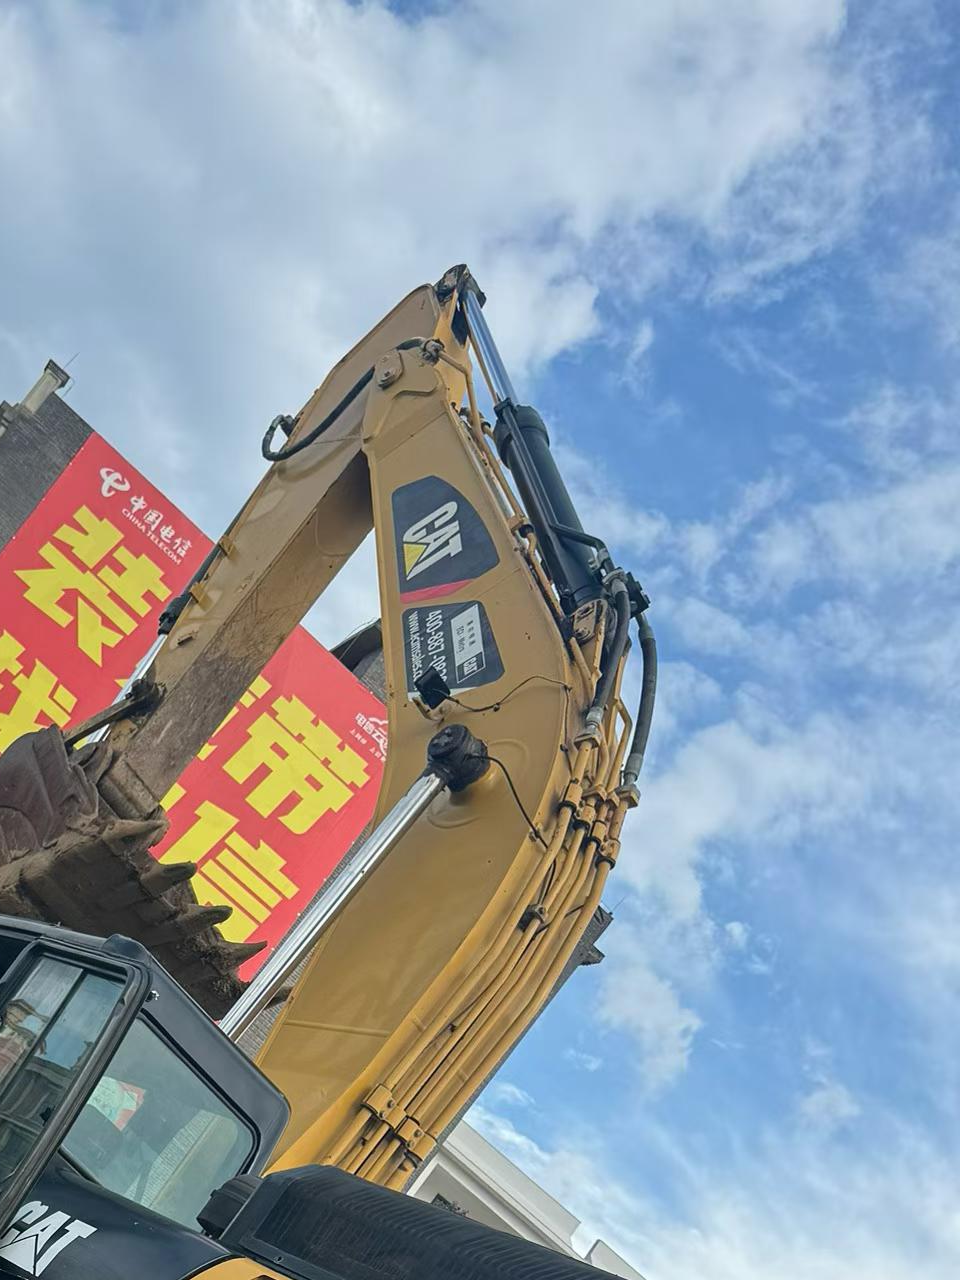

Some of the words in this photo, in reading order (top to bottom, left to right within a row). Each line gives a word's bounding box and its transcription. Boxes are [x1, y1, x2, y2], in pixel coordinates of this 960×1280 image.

[121, 508, 146, 535] CHINA
[146, 530, 182, 566] TELECOM
[130, 495, 192, 558] 中国电信
[402, 500, 463, 581] CAT
[13, 504, 371, 835] 装带
[463, 656, 478, 676] CAT
